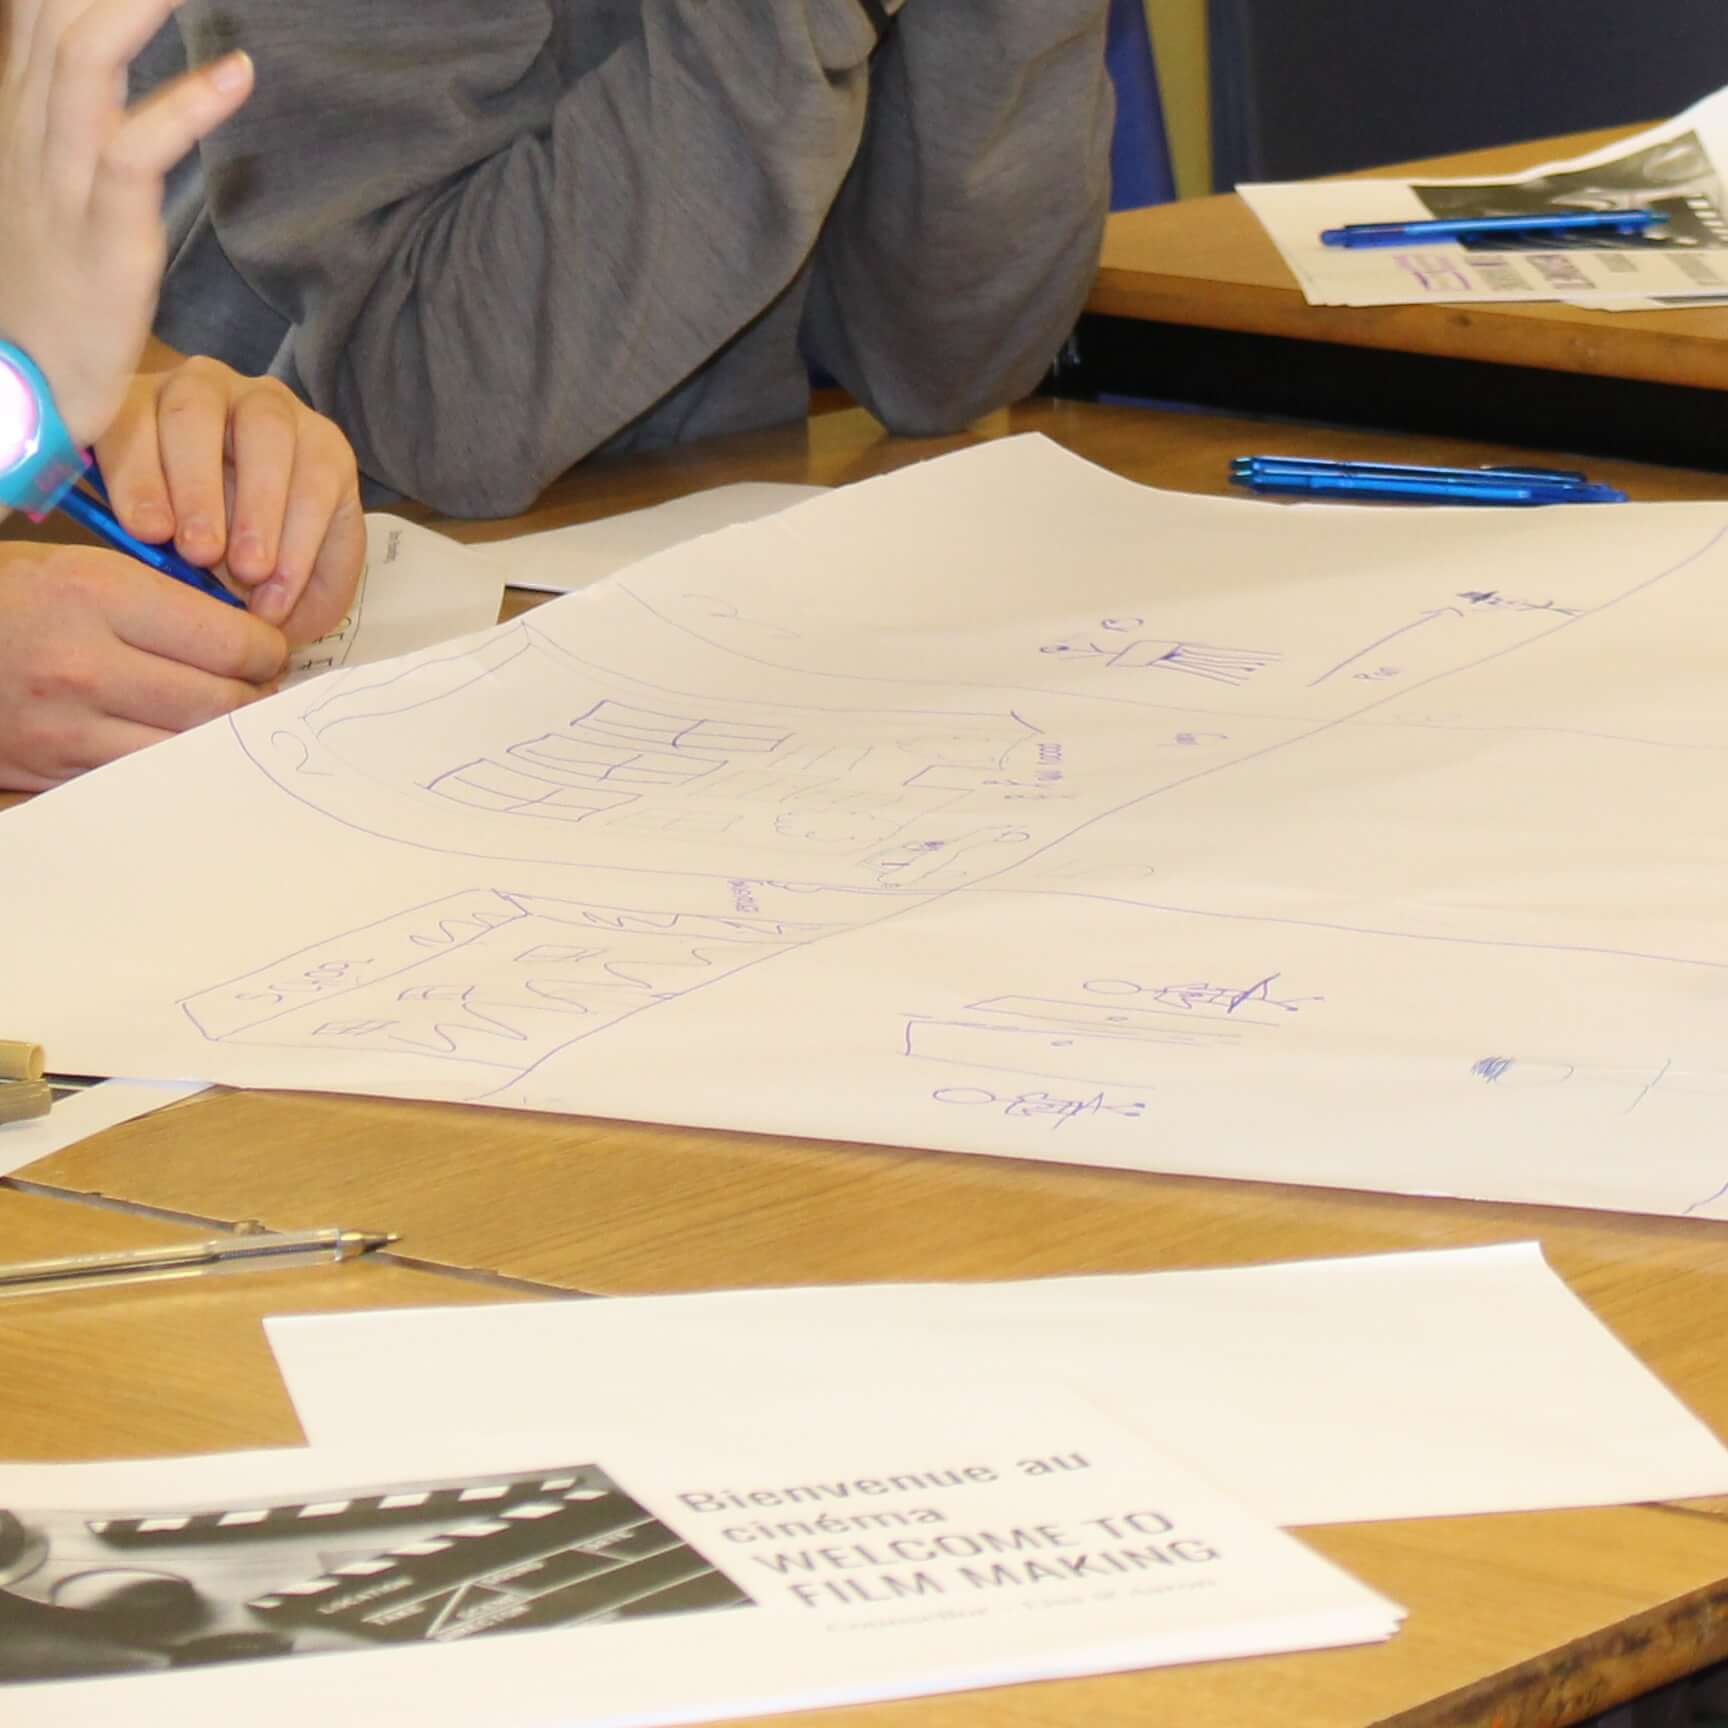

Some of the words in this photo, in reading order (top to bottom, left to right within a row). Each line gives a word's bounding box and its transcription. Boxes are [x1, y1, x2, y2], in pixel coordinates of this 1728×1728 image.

[676, 1464, 1001, 1514] Bienvenue
[1015, 1451, 1092, 1475] au
[720, 1504, 948, 1544] cinéma
[752, 1524, 1082, 1576] WELCOME
[1081, 1509, 1176, 1541] TO
[788, 1571, 946, 1608] FILM
[957, 1537, 1224, 1588] MAKING
